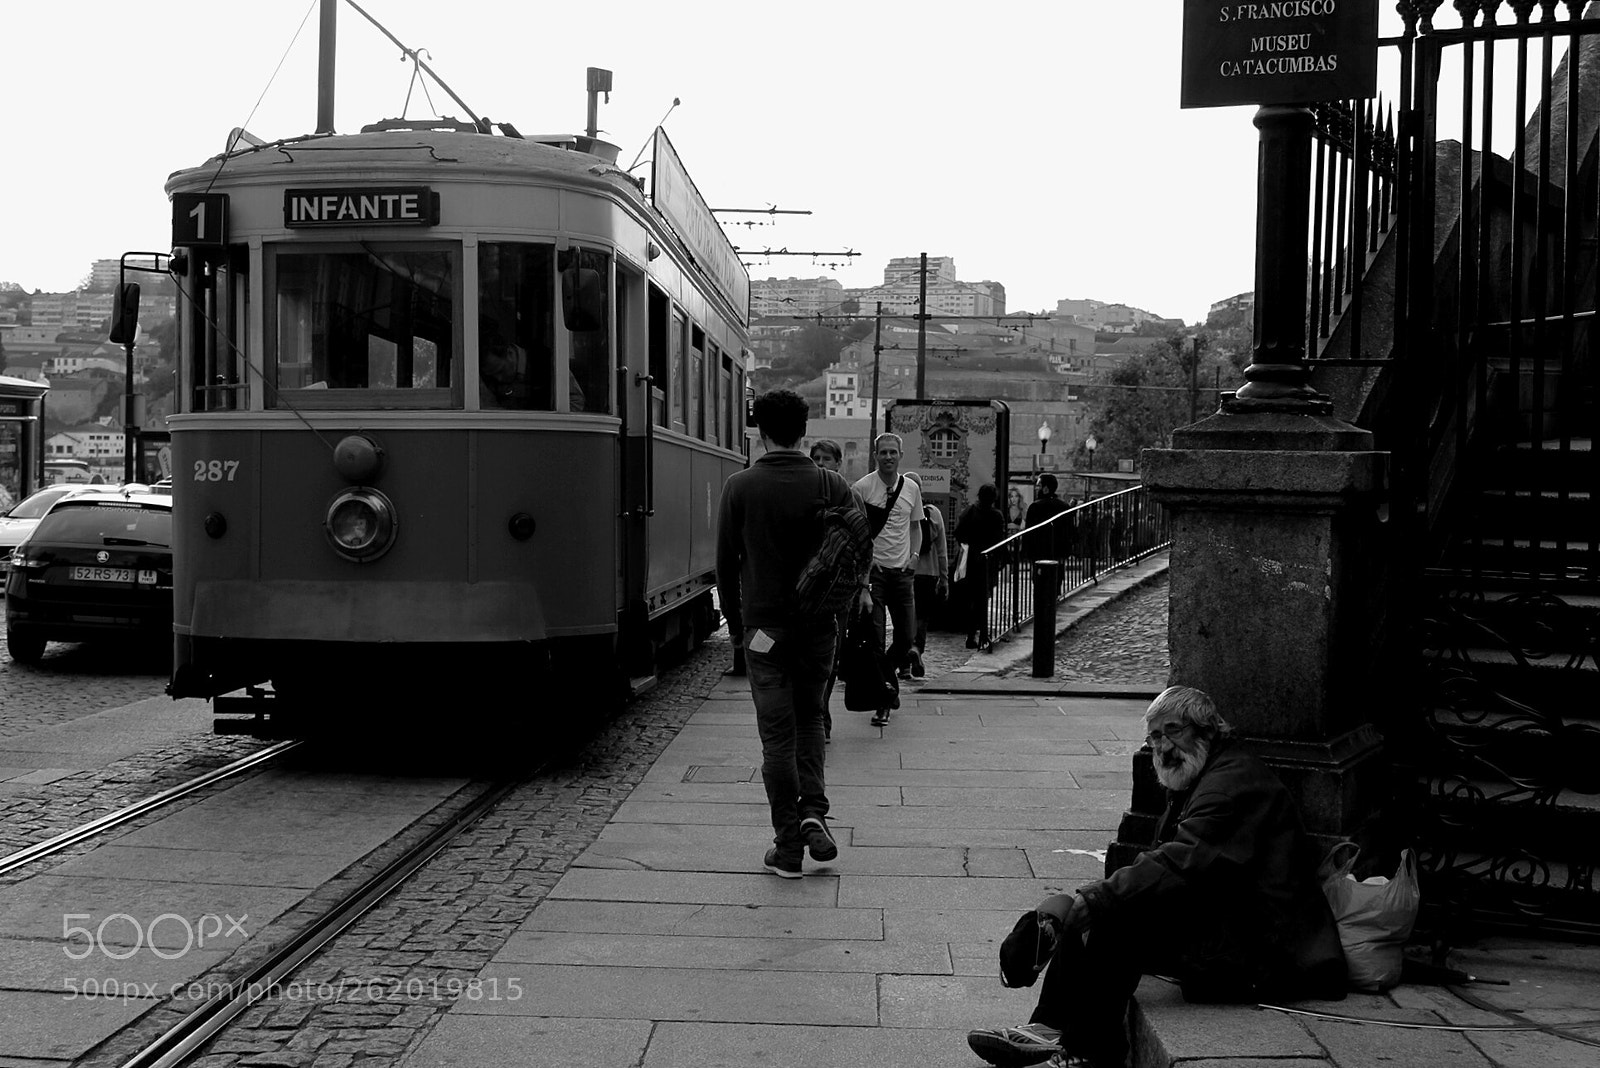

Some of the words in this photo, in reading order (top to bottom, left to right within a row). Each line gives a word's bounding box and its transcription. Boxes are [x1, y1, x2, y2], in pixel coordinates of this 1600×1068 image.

[1250, 33, 1311, 53] MUSEU
[1220, 54, 1337, 77] CATACUMBAS
[291, 194, 418, 221] INFANTE
[189, 202, 207, 239] 1
[193, 461, 239, 482] 287
